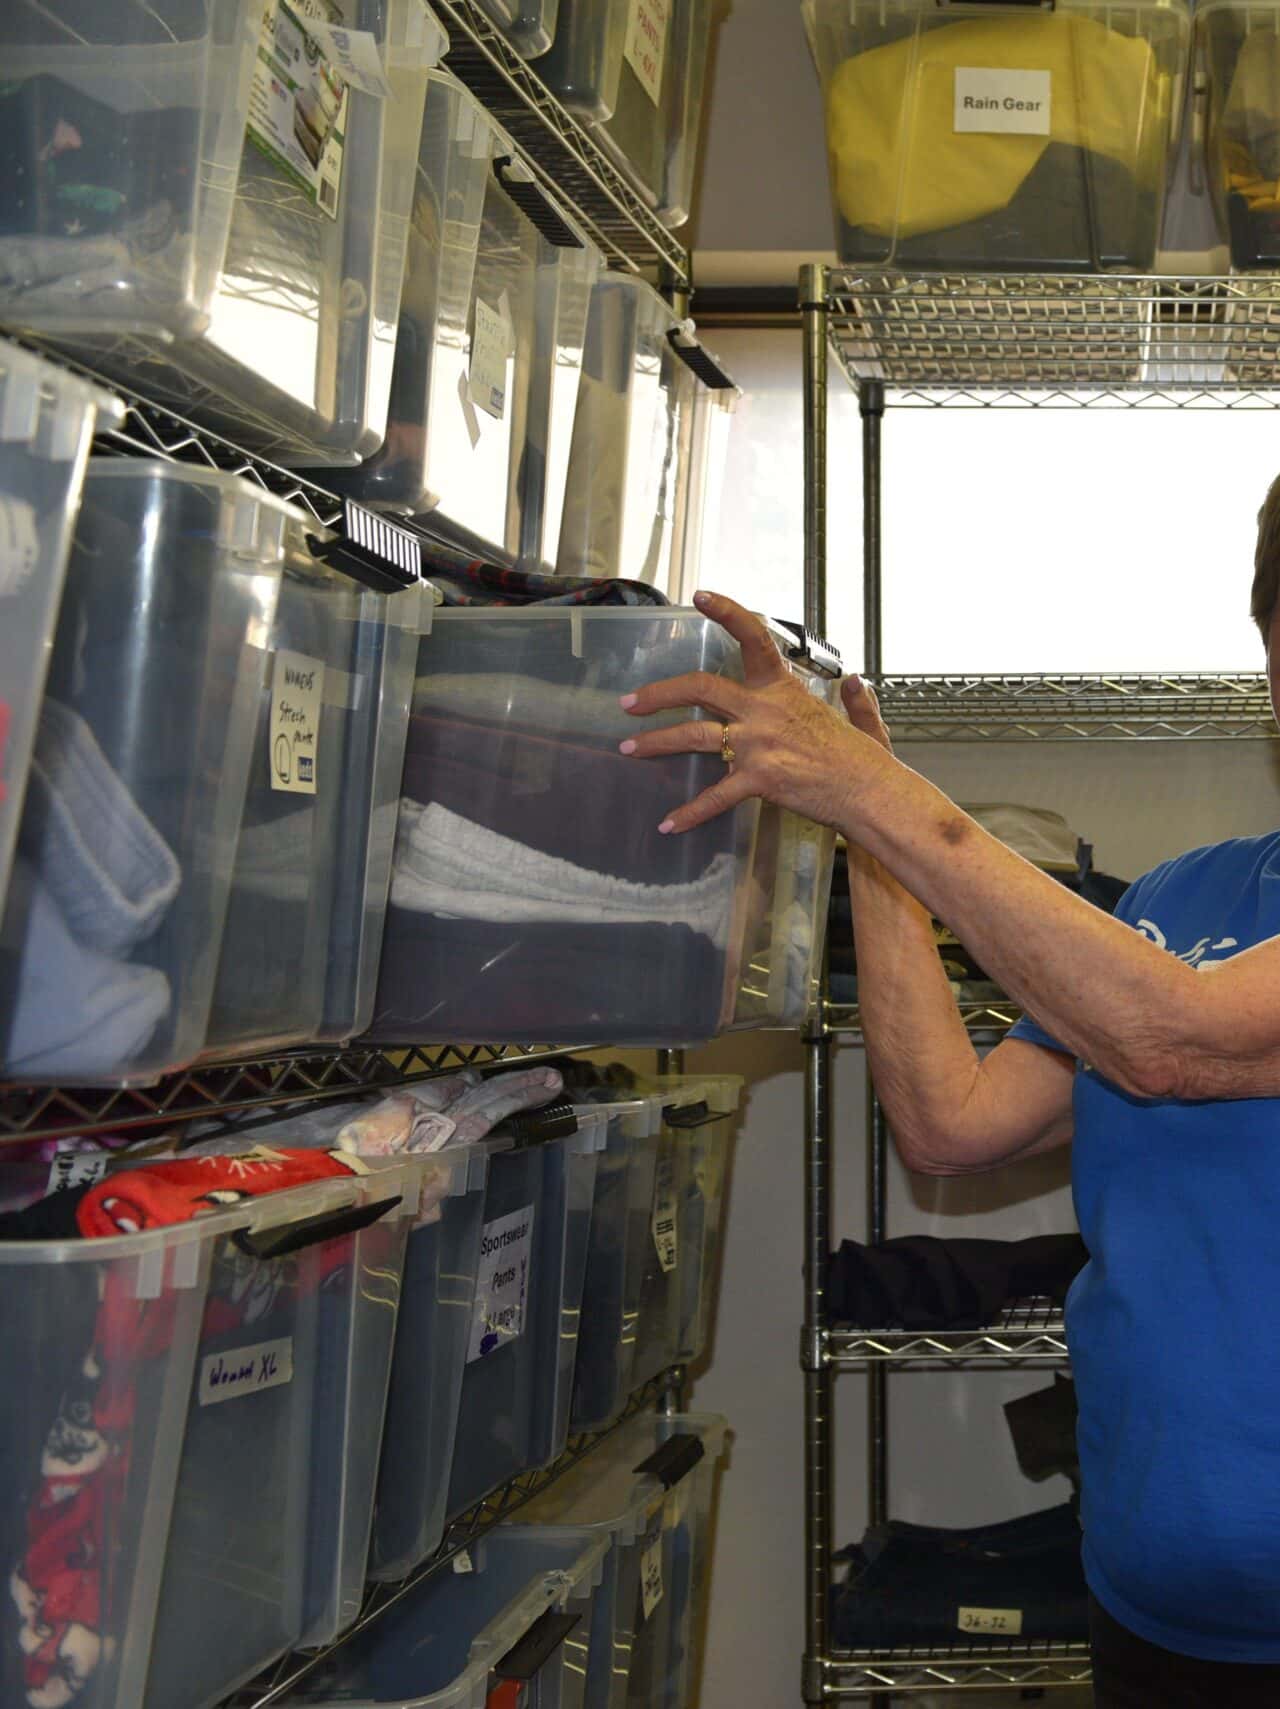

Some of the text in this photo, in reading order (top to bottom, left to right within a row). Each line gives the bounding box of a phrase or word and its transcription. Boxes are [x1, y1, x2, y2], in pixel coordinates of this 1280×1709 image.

[963, 95, 1041, 112] Rain Gear
[480, 1222, 530, 1257] Sportswear
[491, 1266, 517, 1292] Pants
